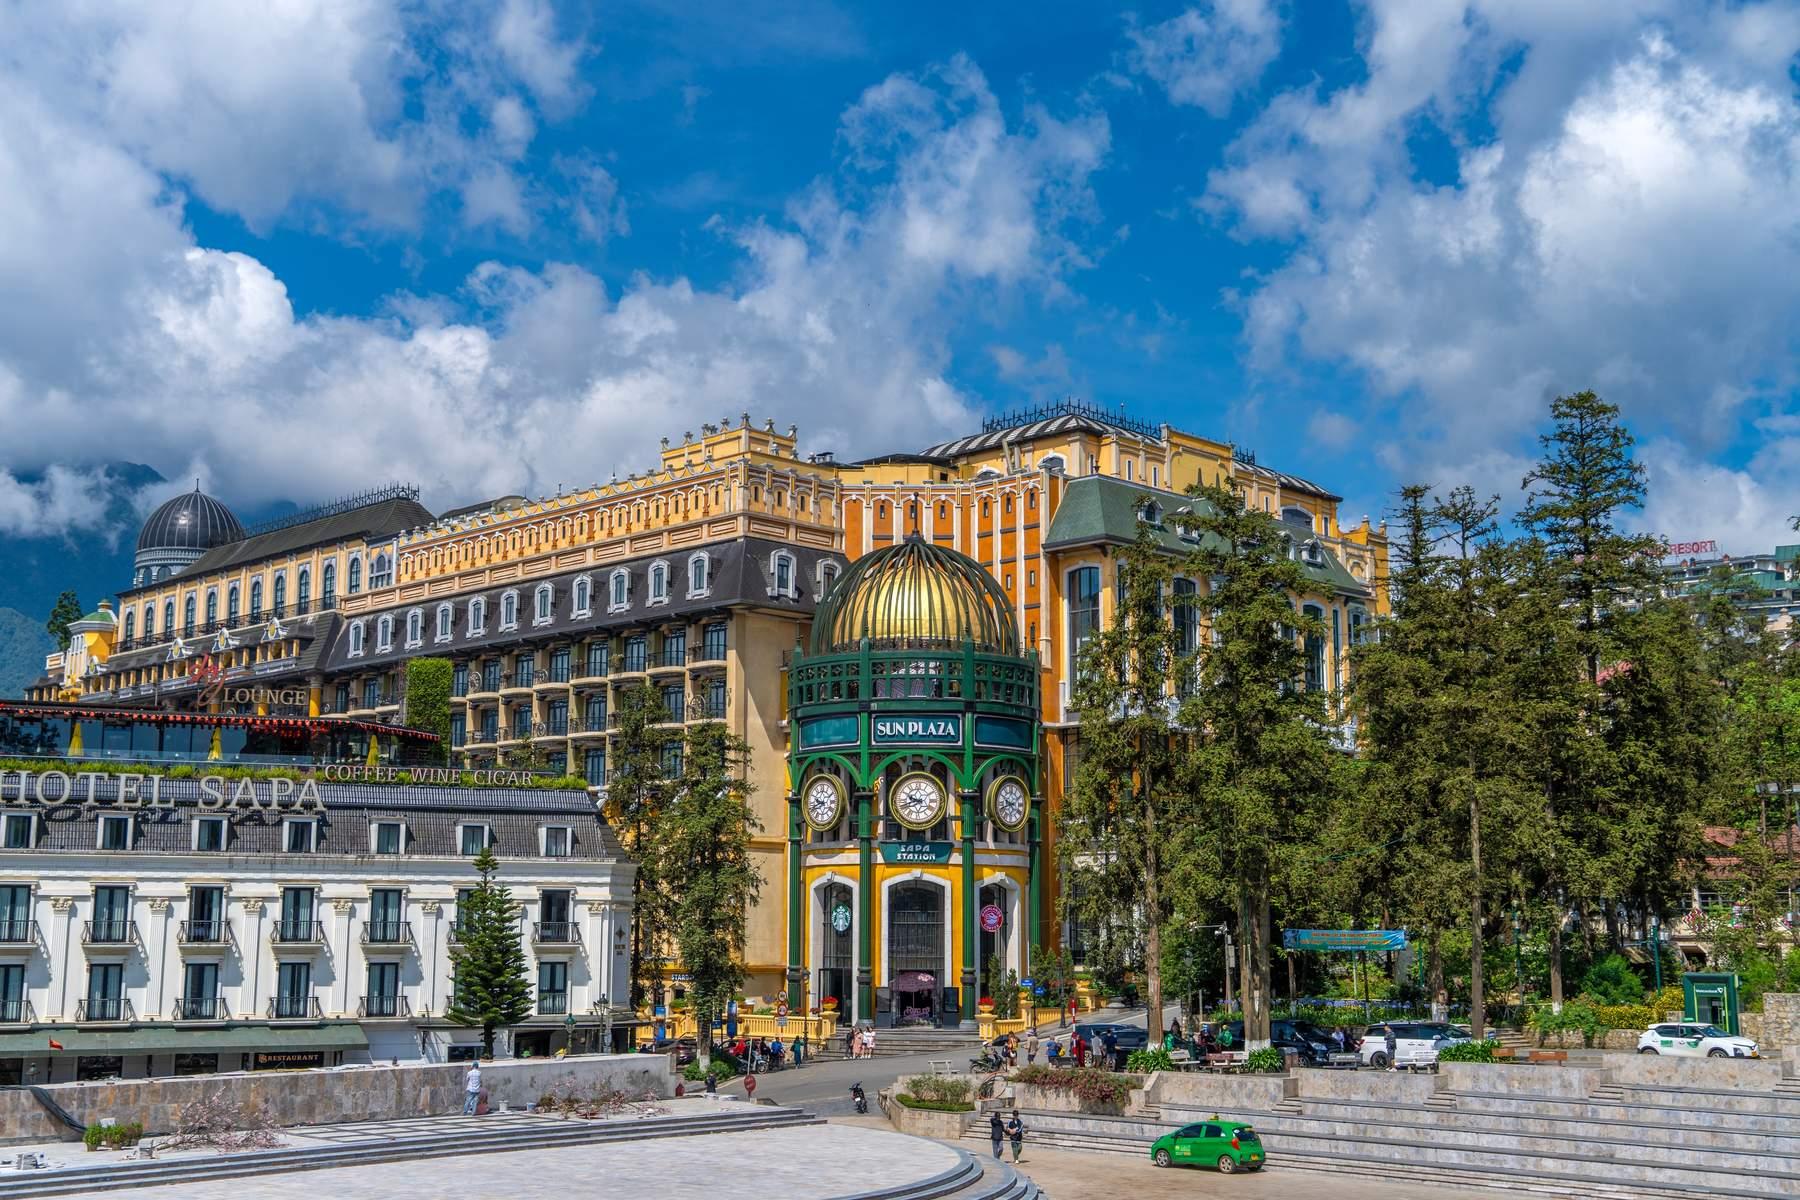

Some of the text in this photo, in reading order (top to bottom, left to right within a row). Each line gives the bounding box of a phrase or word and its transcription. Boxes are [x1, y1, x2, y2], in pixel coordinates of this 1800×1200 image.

[1669, 541, 1714, 555] RESORT
[223, 687, 309, 706] LOUNGE
[877, 721, 956, 736] SUN PLAZA
[324, 764, 533, 786] COFFEE WINE CIGAR
[0, 770, 328, 811] HOTEL SAPA
[900, 844, 930, 852] SAPA
[896, 853, 936, 861] STATION
